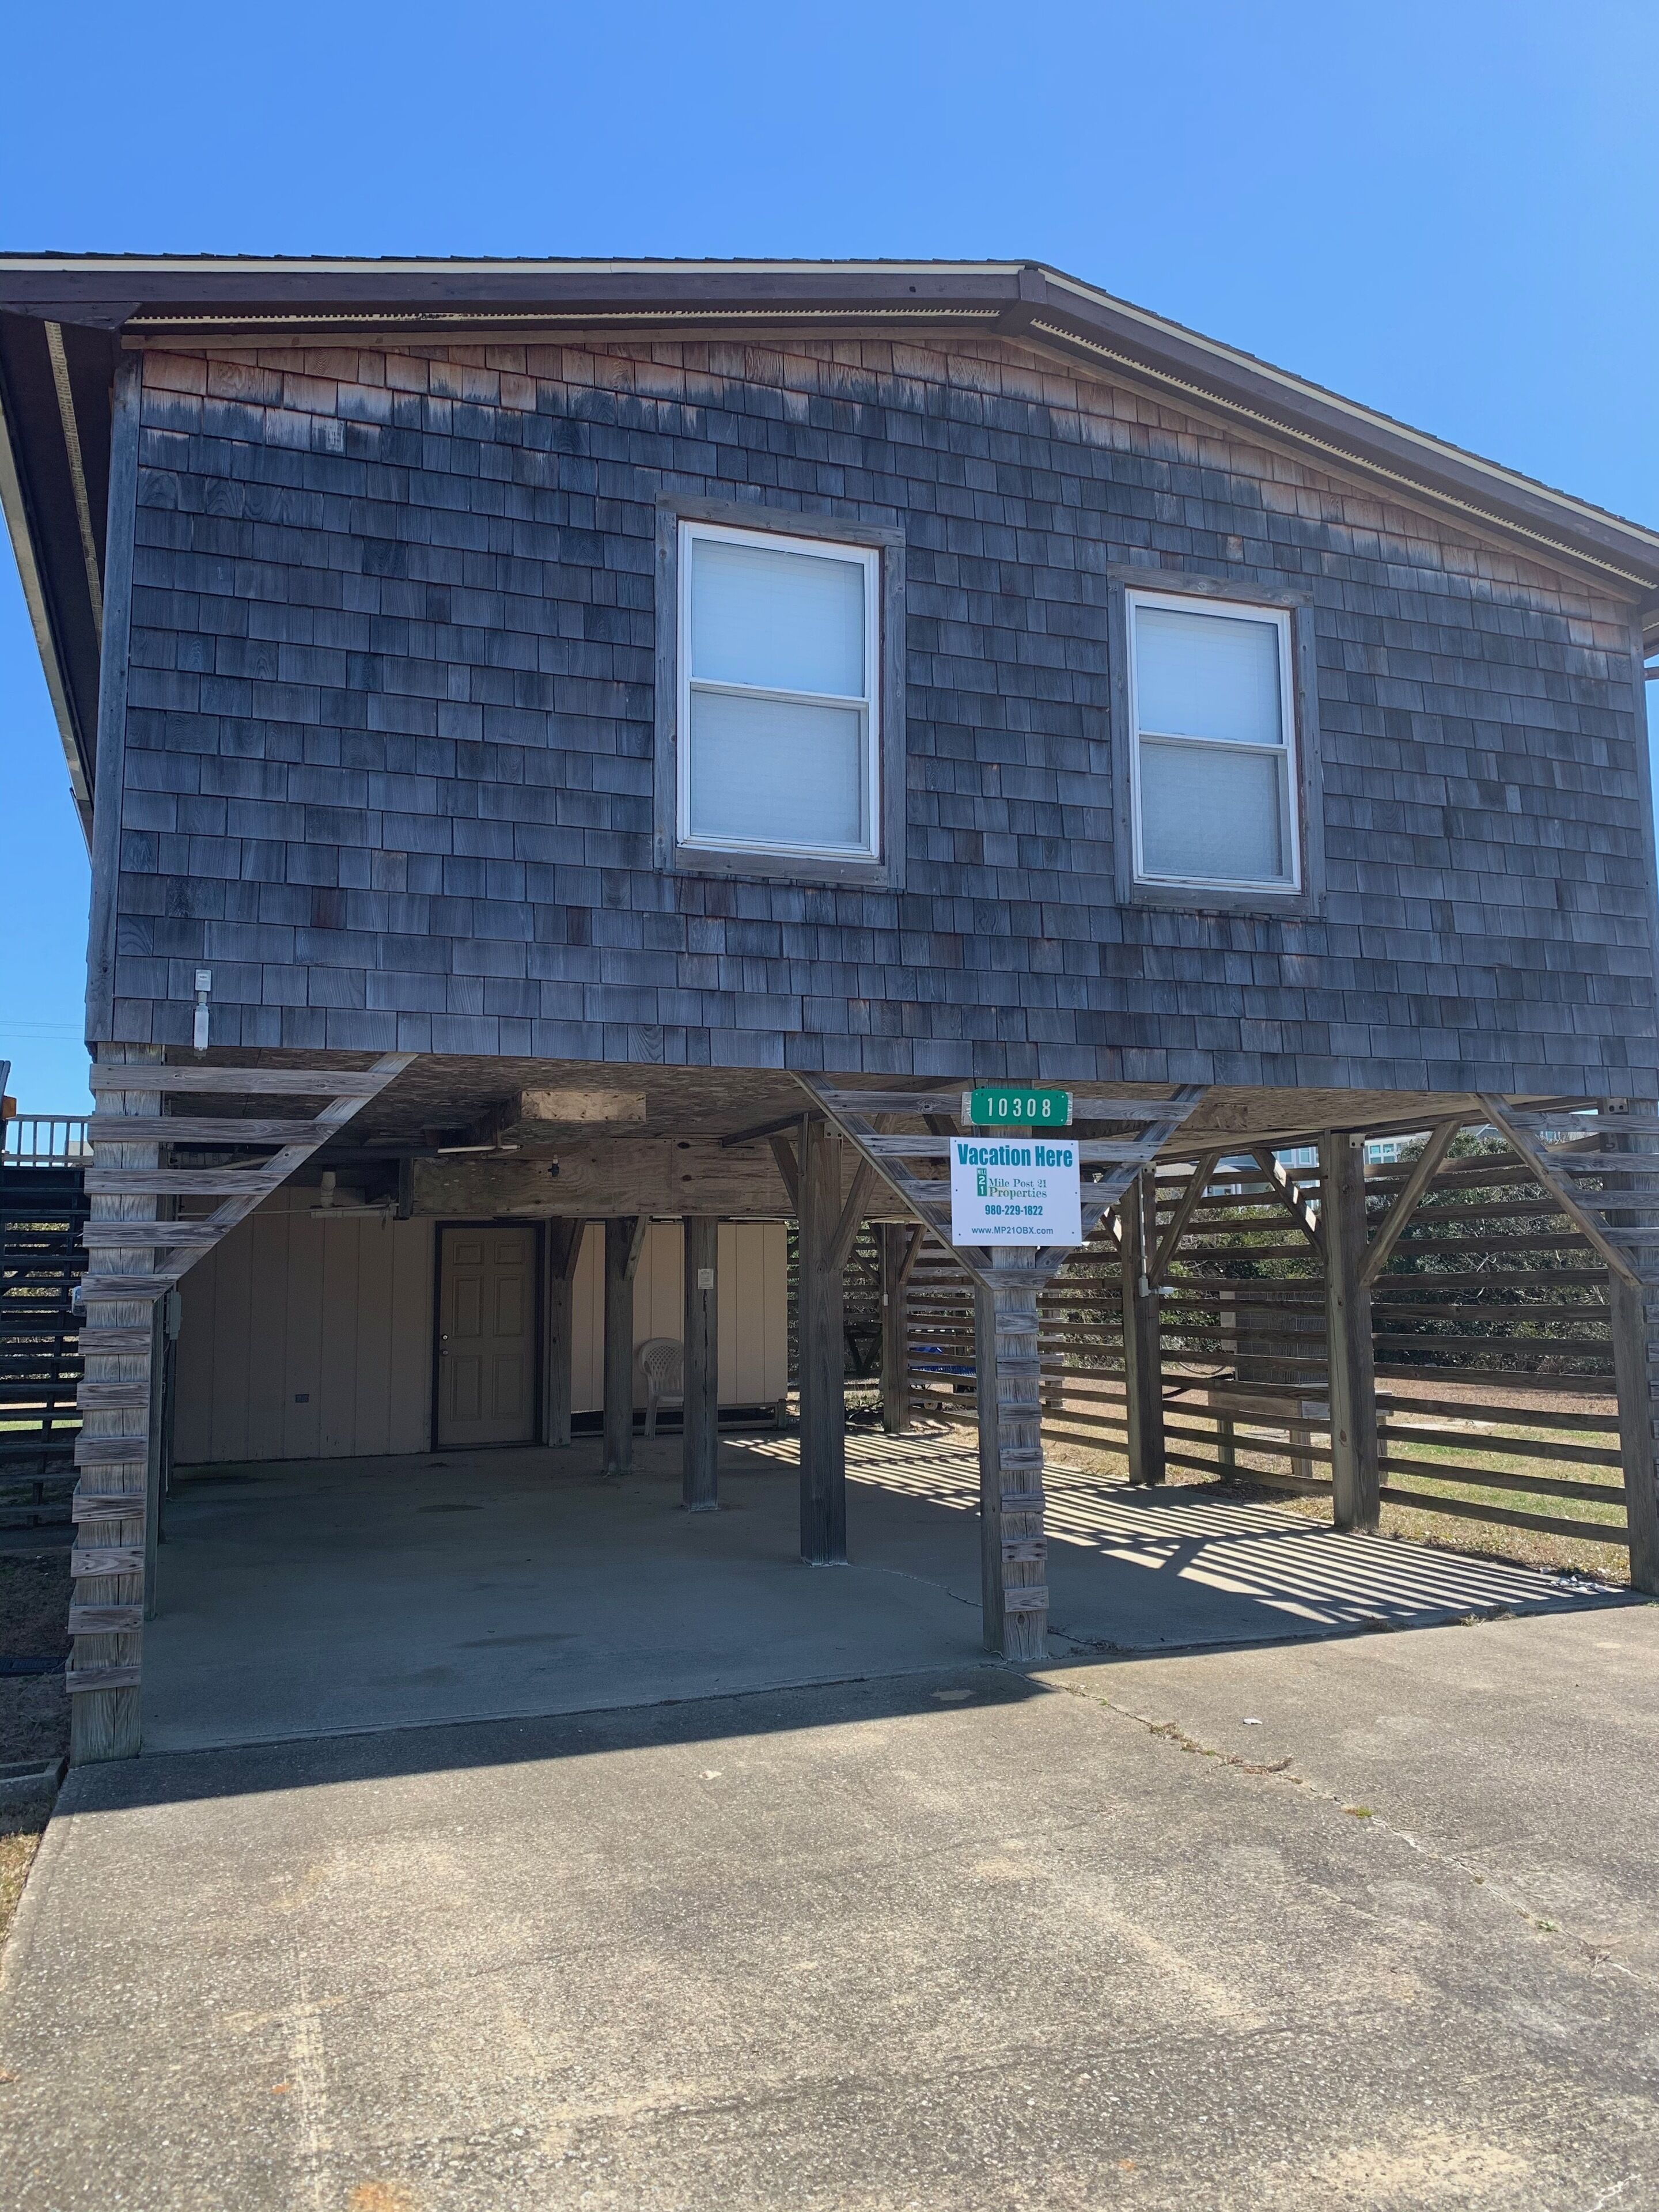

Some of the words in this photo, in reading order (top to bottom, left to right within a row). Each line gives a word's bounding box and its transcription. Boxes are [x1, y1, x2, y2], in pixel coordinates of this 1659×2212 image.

[987, 1097, 1051, 1118] 10308
[957, 1143, 1031, 1166] Vacation
[1035, 1145, 1073, 1168] Here
[988, 1178, 1010, 1187] Mile
[1013, 1179, 1034, 1188] Post
[1037, 1179, 1047, 1188] 21
[988, 1187, 1047, 1200] Properties
[984, 1205, 1043, 1215] 980-229-1822
